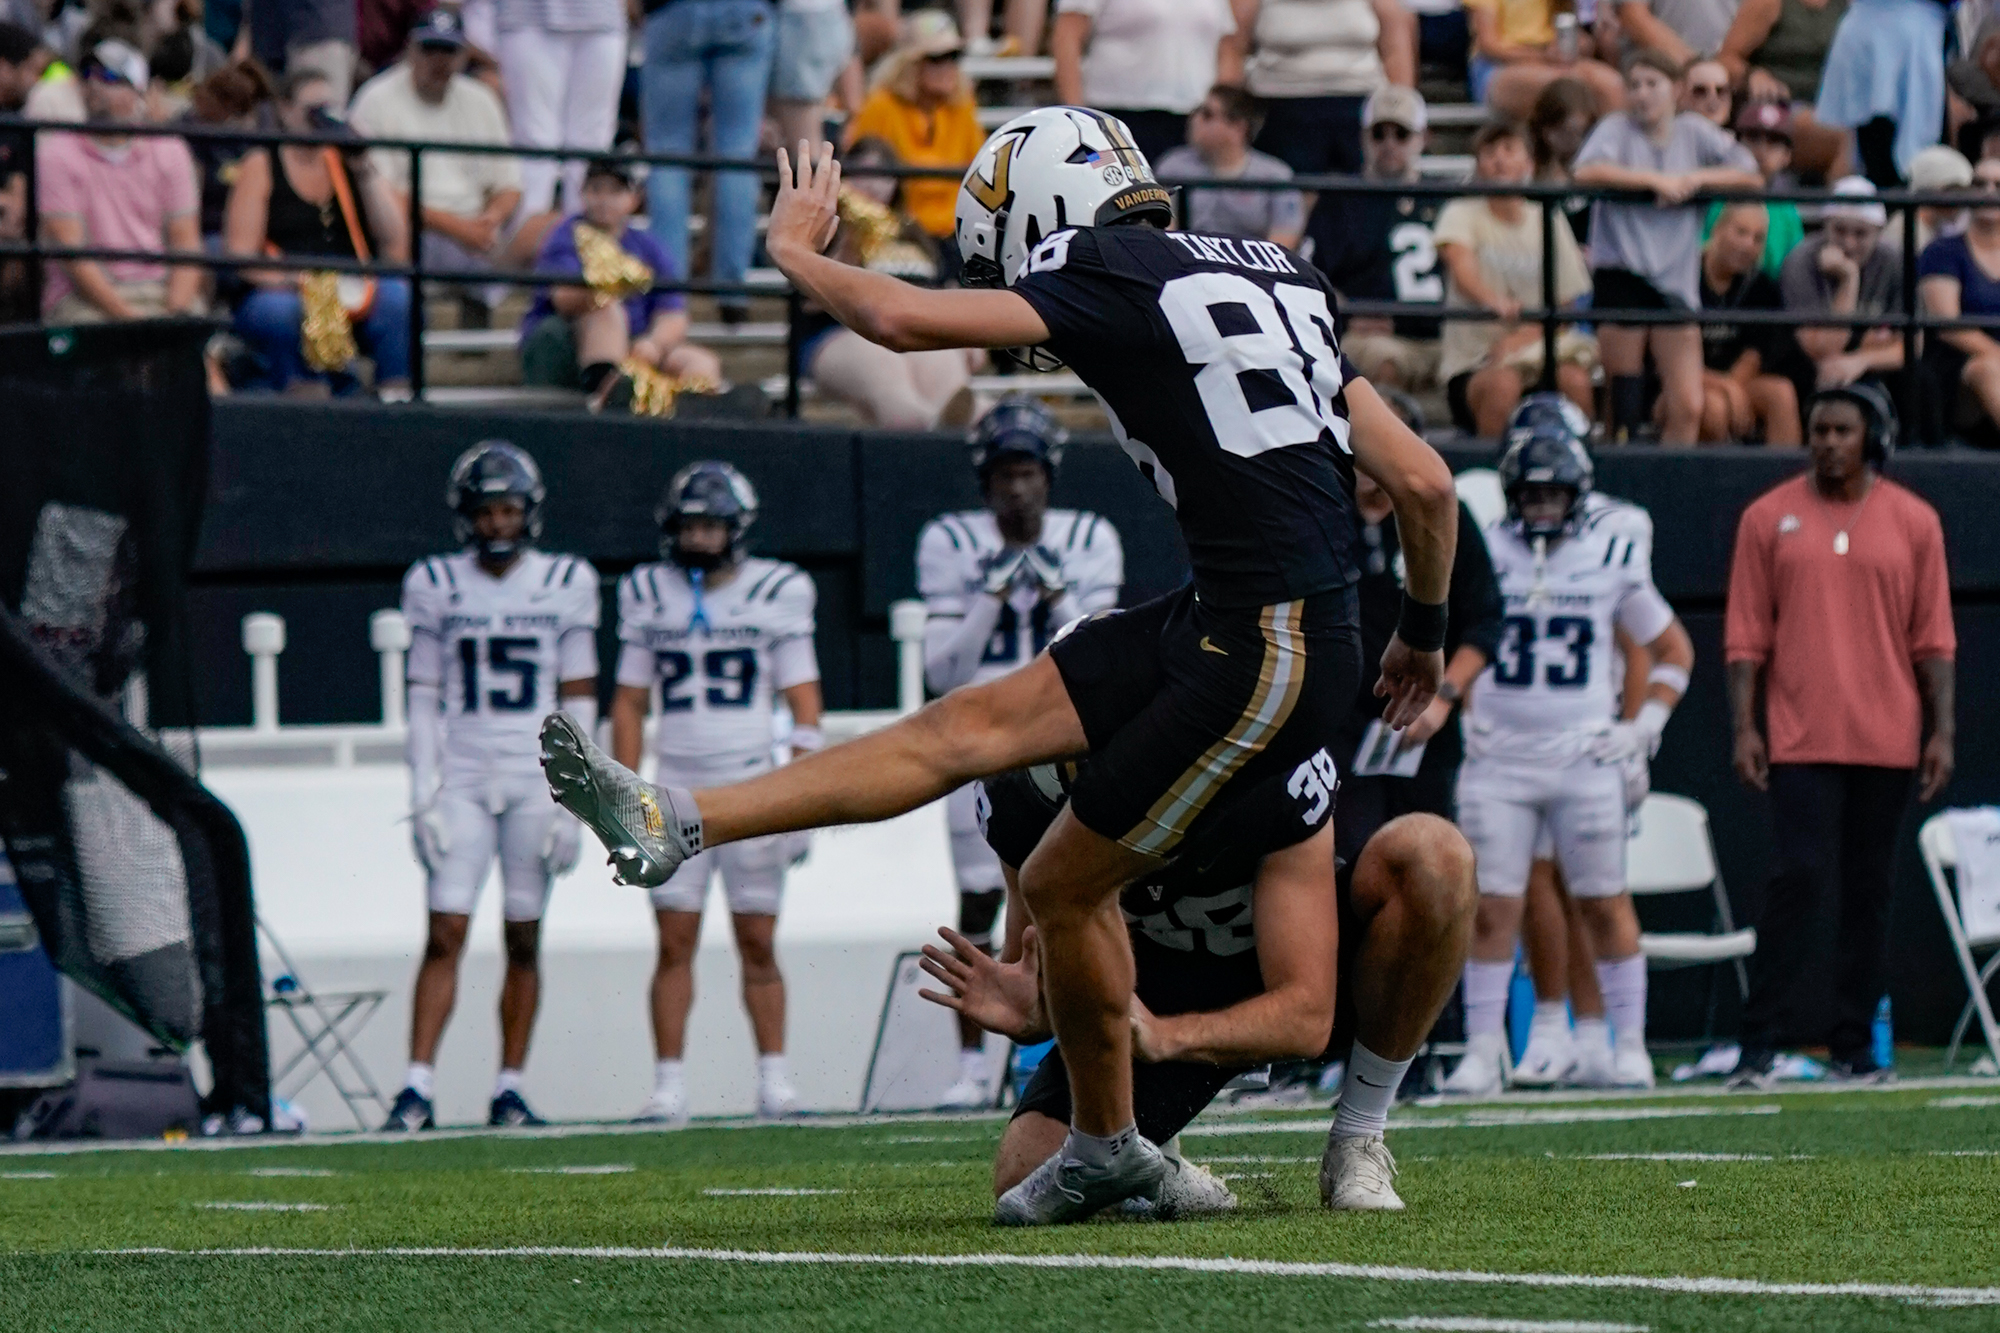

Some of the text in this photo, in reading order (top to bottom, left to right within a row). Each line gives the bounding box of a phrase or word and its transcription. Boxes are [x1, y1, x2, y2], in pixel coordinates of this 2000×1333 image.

[1103, 166, 1123, 186] SEC
[1018, 229, 1078, 279] 8
[1165, 232, 1298, 274] TAYLOR
[1389, 222, 1443, 301] 2
[1159, 272, 1353, 458] 88
[459, 637, 541, 713] 15
[655, 647, 757, 713] 29
[1496, 614, 1594, 686] 33
[1287, 747, 1337, 826] 38
[1147, 885, 1164, 901] V
